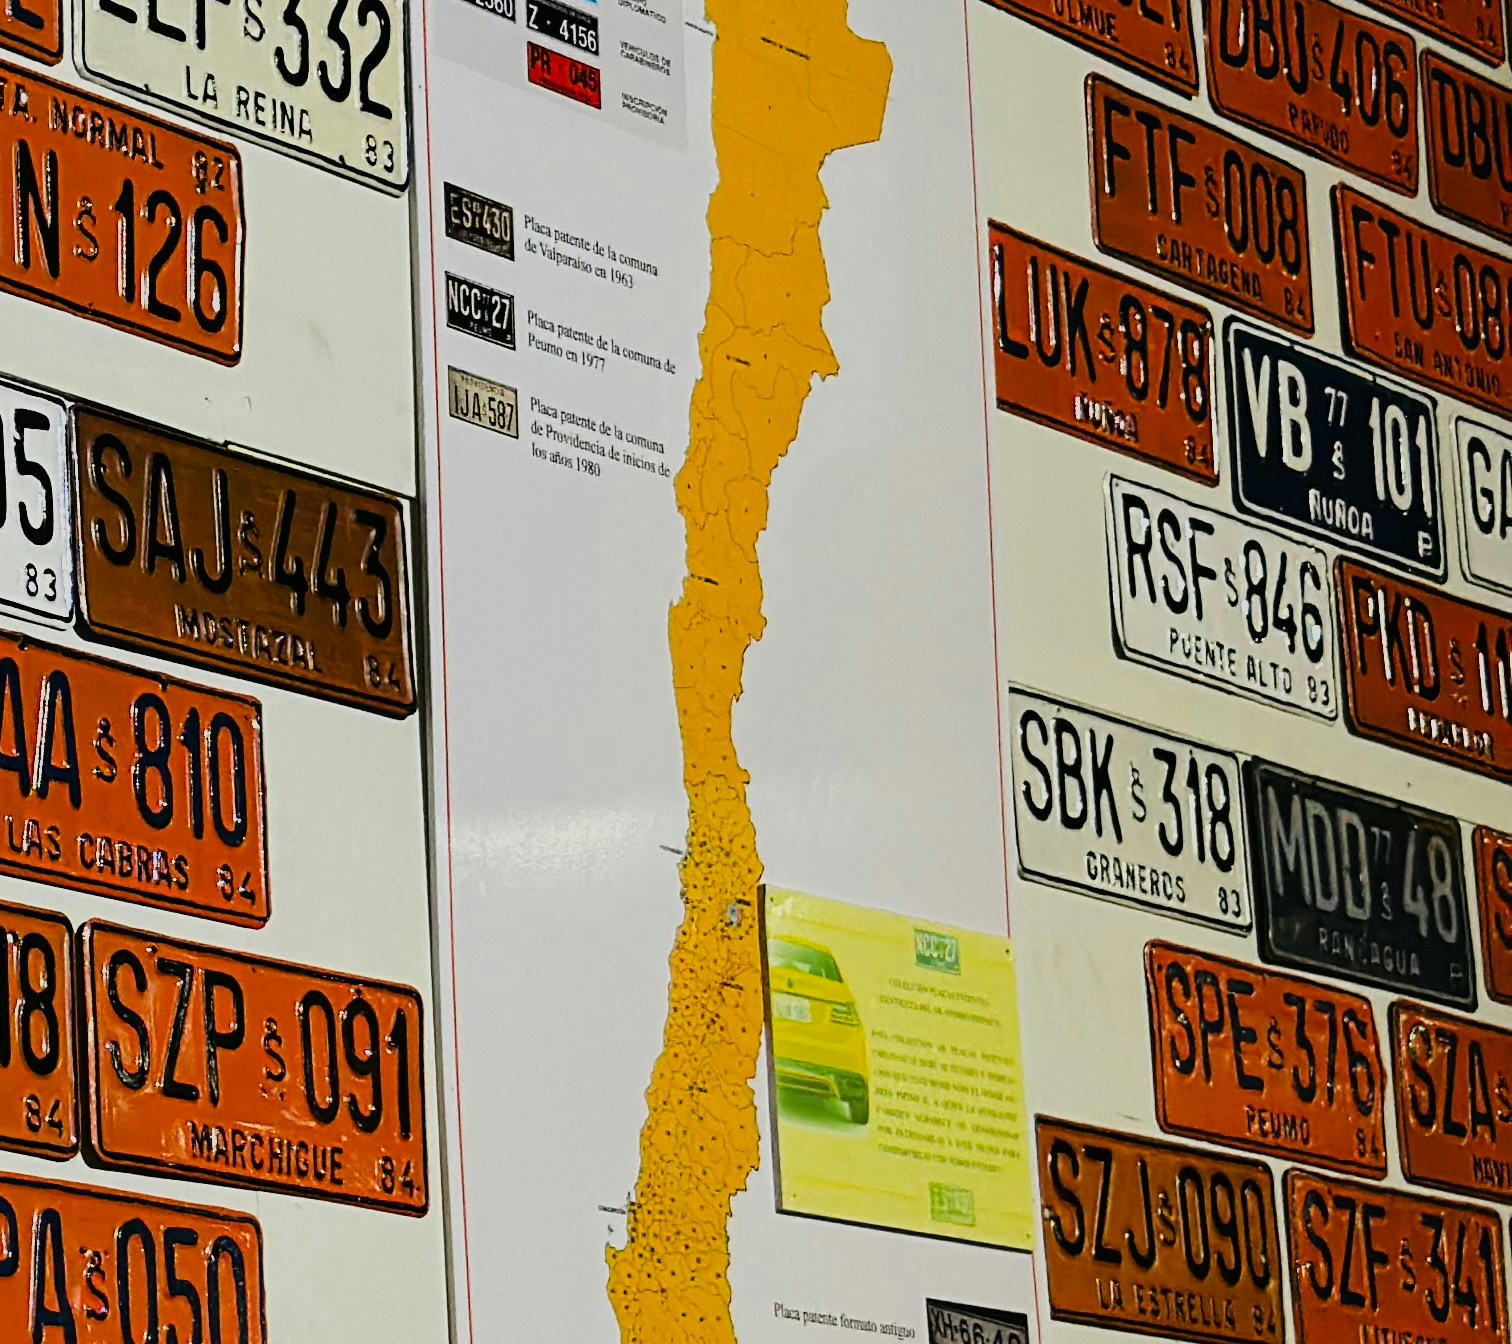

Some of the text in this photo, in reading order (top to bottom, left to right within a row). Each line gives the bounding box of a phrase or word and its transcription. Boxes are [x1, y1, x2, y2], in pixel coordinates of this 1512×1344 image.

[185, 66, 395, 174] LA REINA 83
[524, 214, 658, 276] Placa patente de la comuna
[525, 238, 537, 253] de
[594, 266, 607, 279] en
[610, 267, 633, 288] 1963
[528, 332, 605, 371] Peumo en 1977
[531, 419, 670, 478] de Providencia de inicios de
[531, 443, 601, 478] los años 1980
[173, 602, 323, 674] MOSTAZAL
[1169, 628, 1293, 695] PUENTE ALTO
[4, 814, 190, 893] LAS CABRAS
[1086, 851, 1241, 918] GRANEROS 83
[187, 1120, 345, 1187] MARCHIGUE
[1246, 1105, 1310, 1146] PEUMO
[774, 1302, 916, 1341] Placa patente formato antiguo
